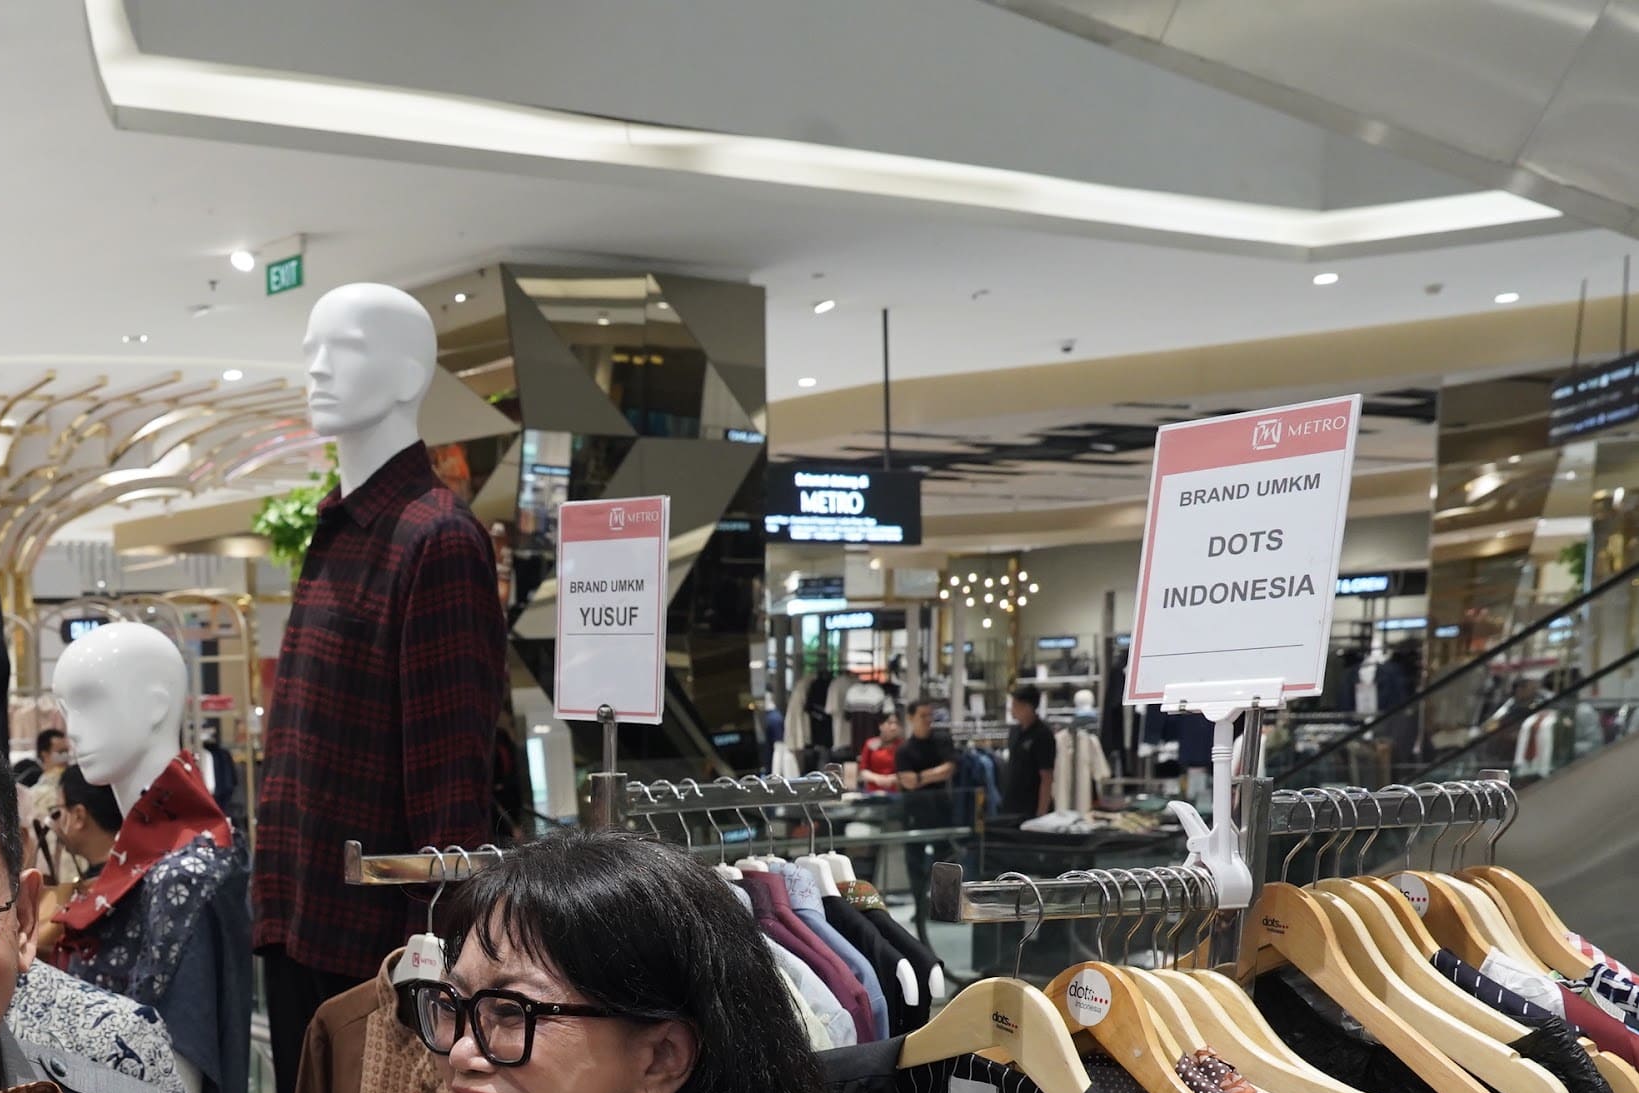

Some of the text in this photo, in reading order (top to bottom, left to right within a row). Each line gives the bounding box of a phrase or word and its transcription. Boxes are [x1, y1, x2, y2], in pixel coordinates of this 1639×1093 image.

[269, 260, 298, 291] EXIT
[1287, 416, 1346, 437] METRO
[1179, 473, 1321, 506] BRAND UMKM
[800, 490, 865, 515] METRO
[627, 511, 659, 522] METRO
[1207, 528, 1284, 557] DOTS
[570, 579, 644, 593] BRAND UMKM
[1162, 574, 1315, 608] INDONESIA
[580, 606, 639, 626] YUSUF
